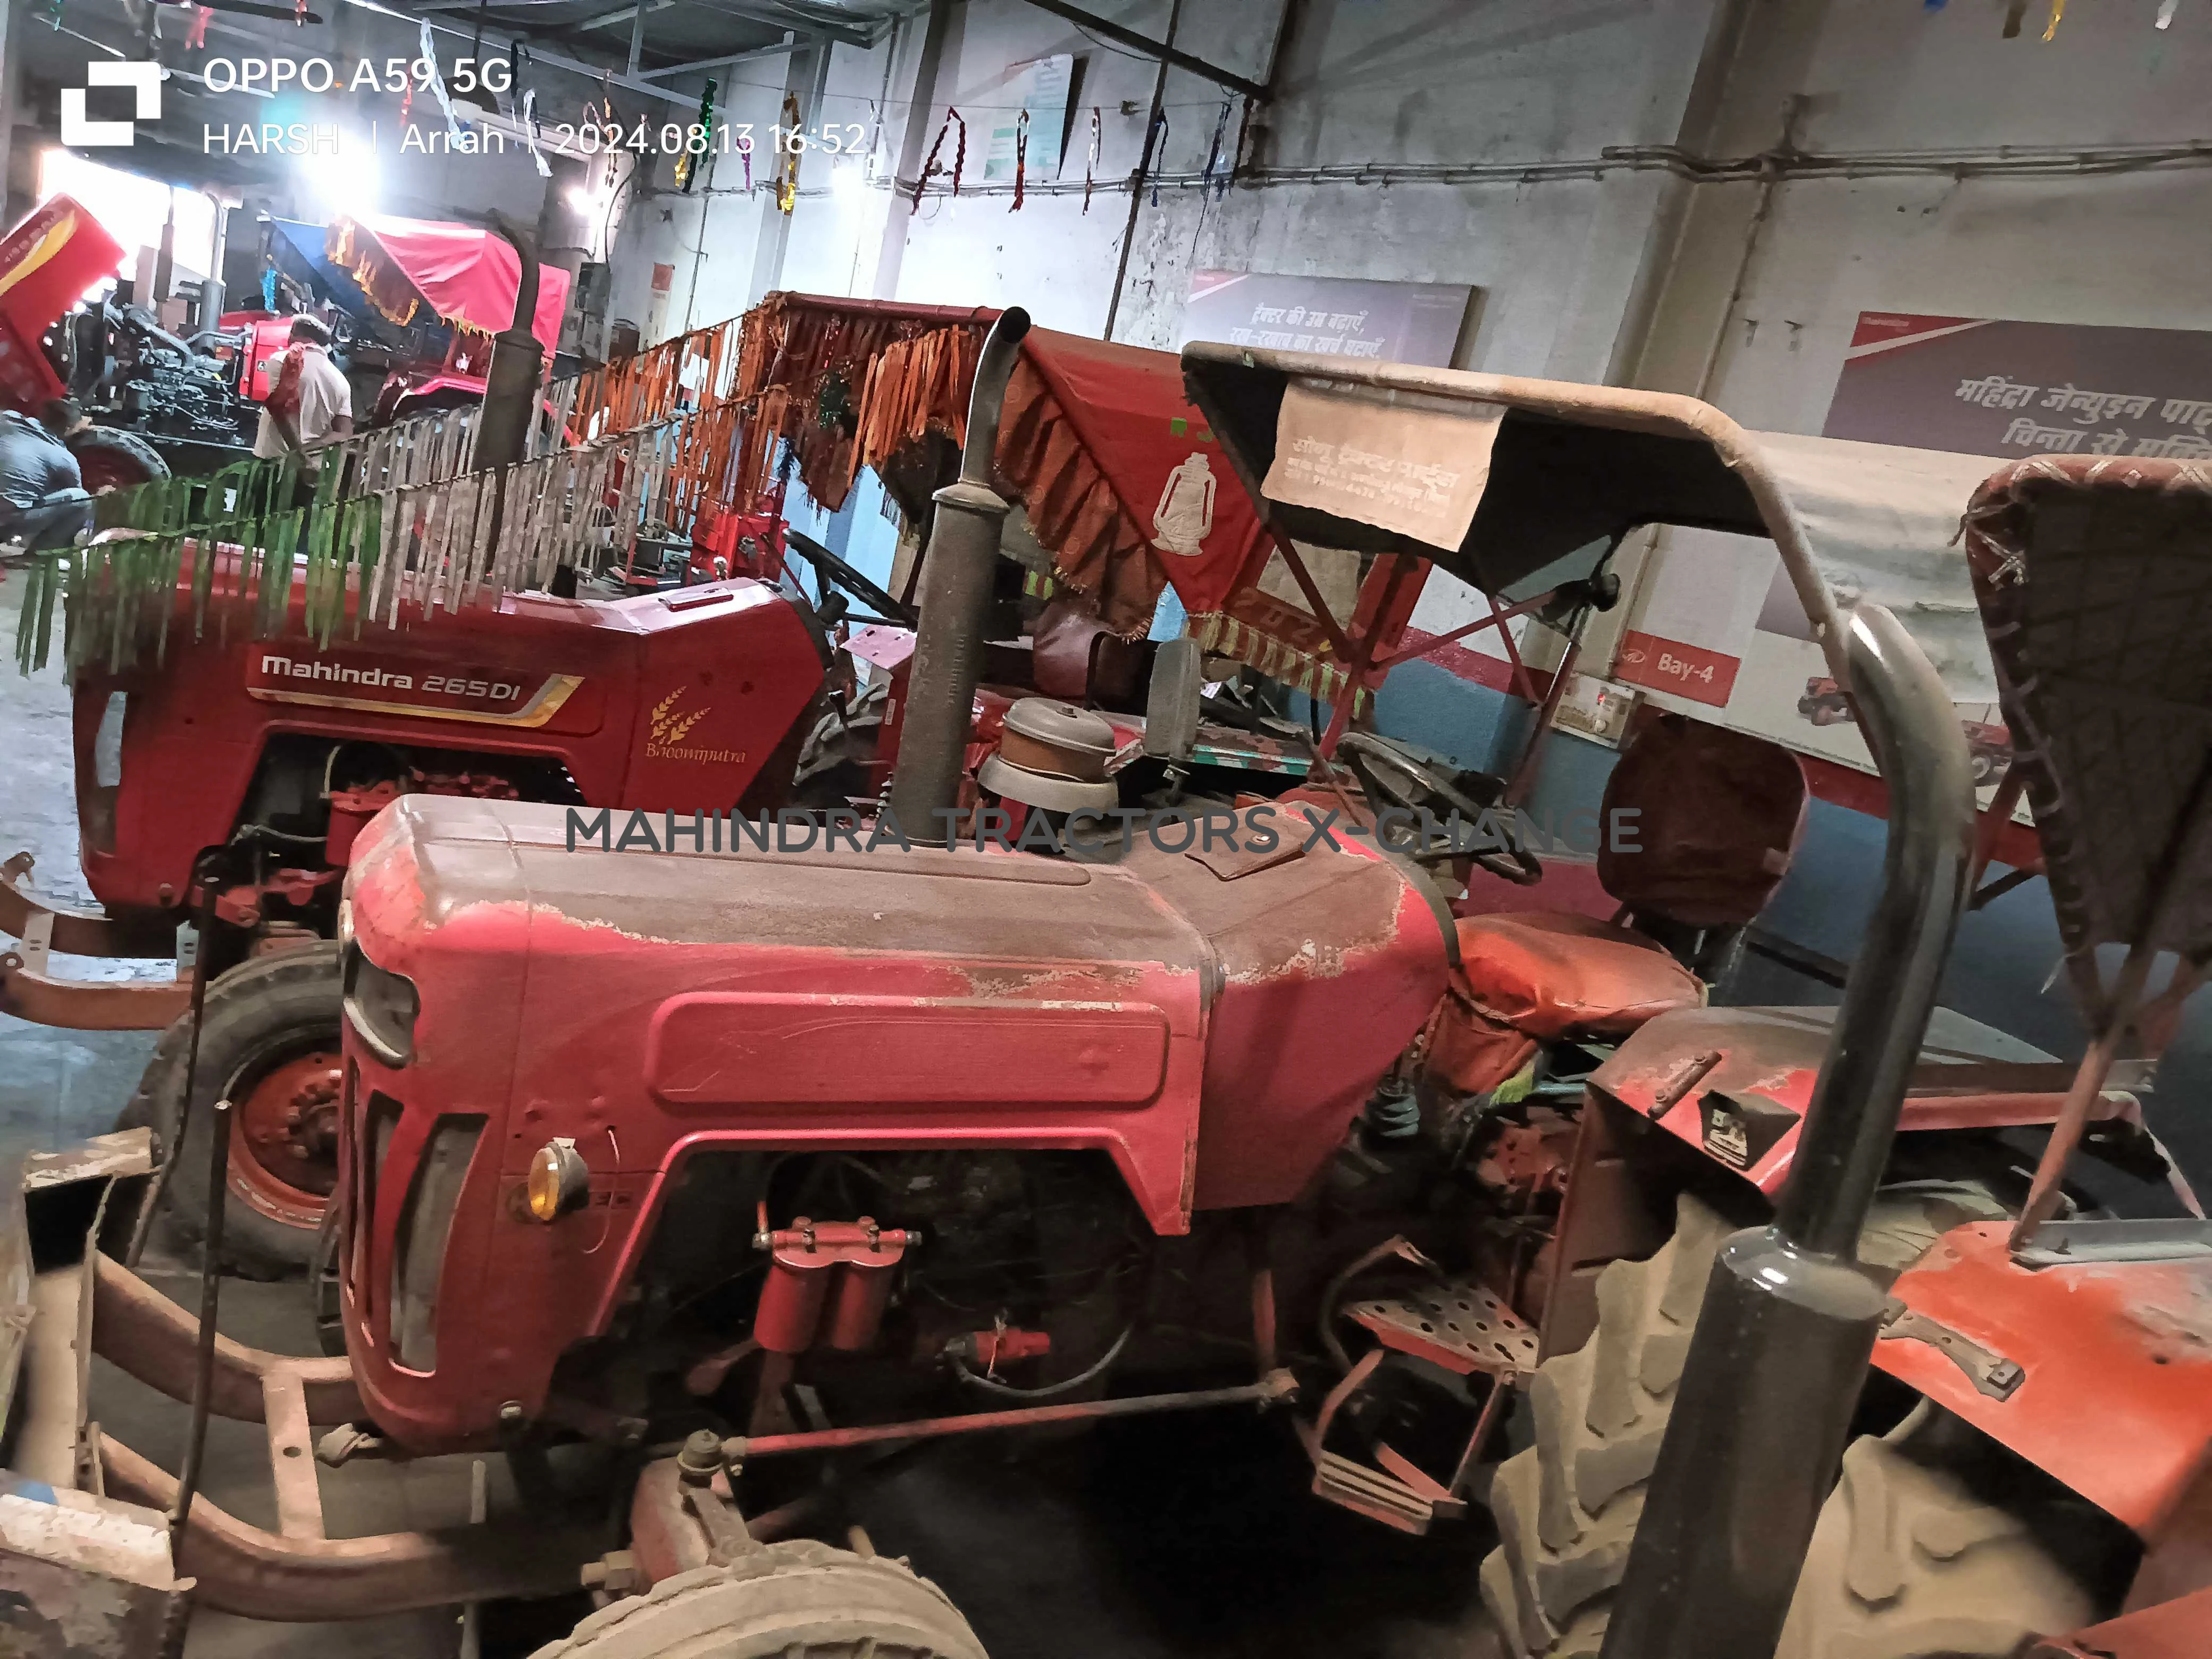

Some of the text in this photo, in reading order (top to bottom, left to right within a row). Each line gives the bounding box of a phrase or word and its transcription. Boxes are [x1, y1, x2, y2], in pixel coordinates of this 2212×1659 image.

[1285, 306, 1306, 325] की
[261, 655, 413, 690] Mahindra
[1657, 653, 1715, 683] Bay-4
